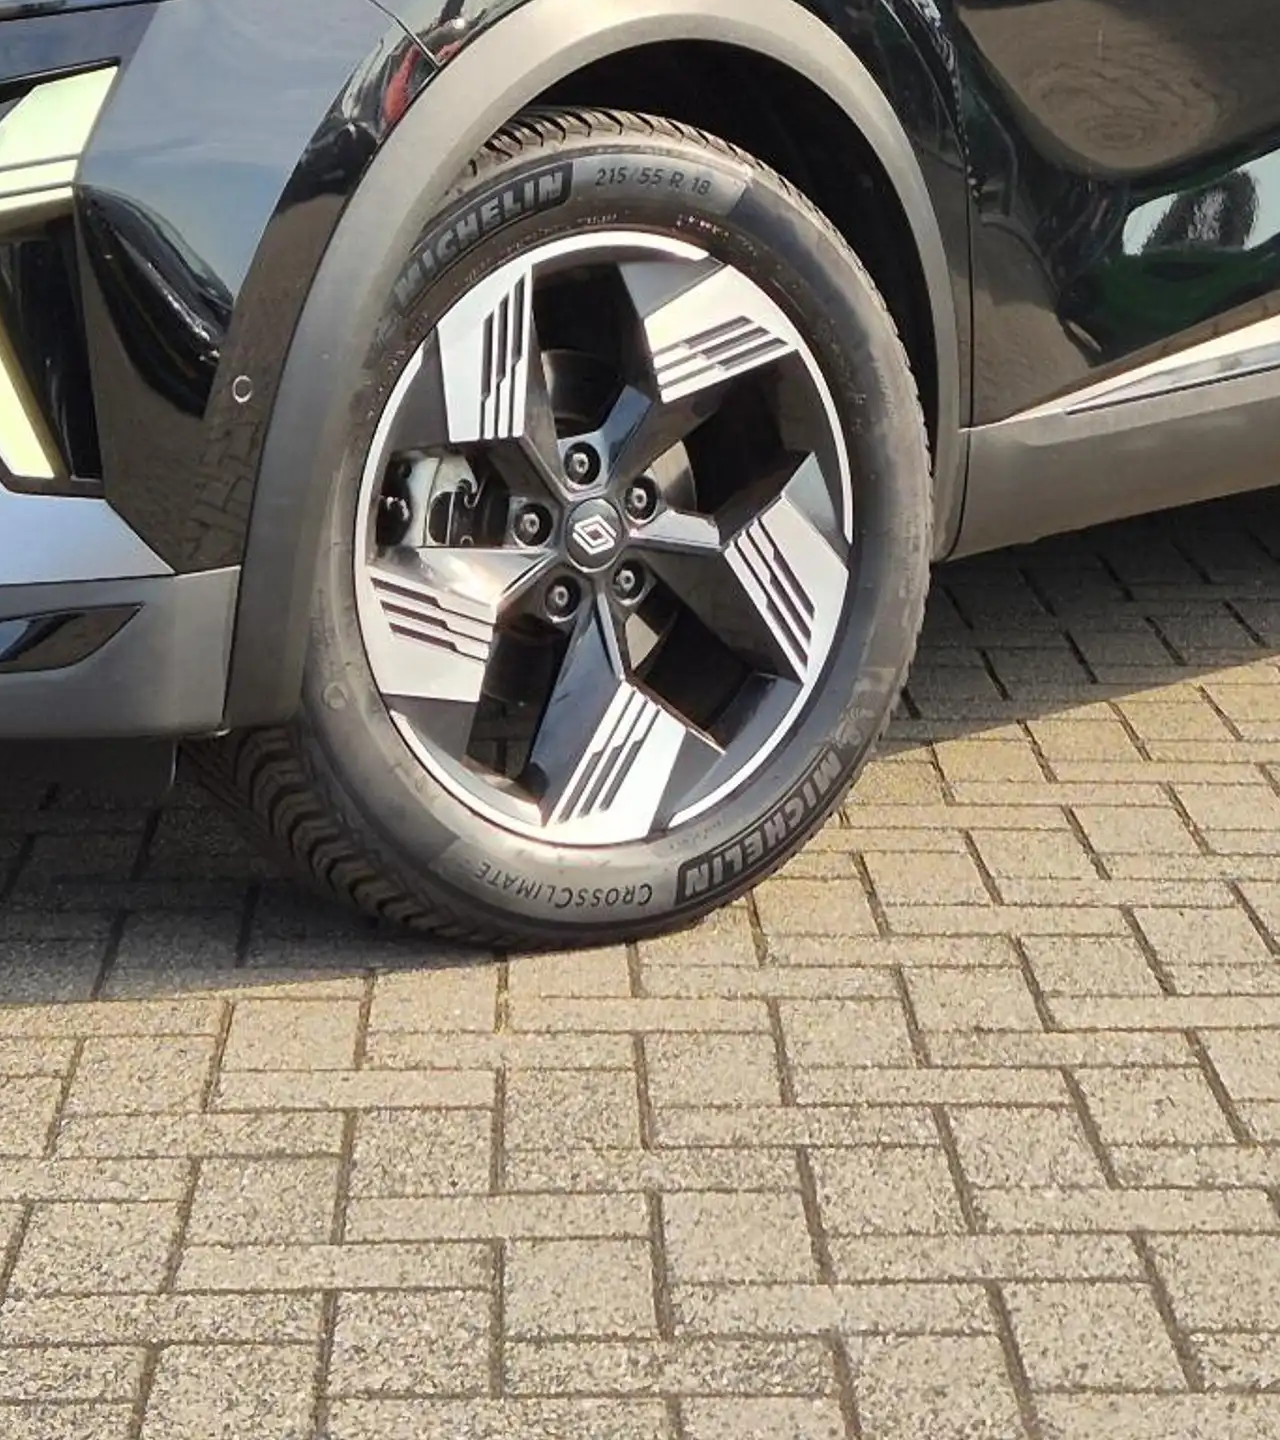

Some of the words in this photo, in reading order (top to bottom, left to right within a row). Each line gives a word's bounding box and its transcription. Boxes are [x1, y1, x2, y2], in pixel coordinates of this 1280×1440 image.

[594, 166, 665, 187] 215/55
[670, 170, 685, 189] R
[691, 176, 712, 196] 18
[392, 171, 564, 308] MICHELIN
[684, 749, 843, 897] MICHELIN
[475, 861, 653, 909] CROSSCLIMATE
